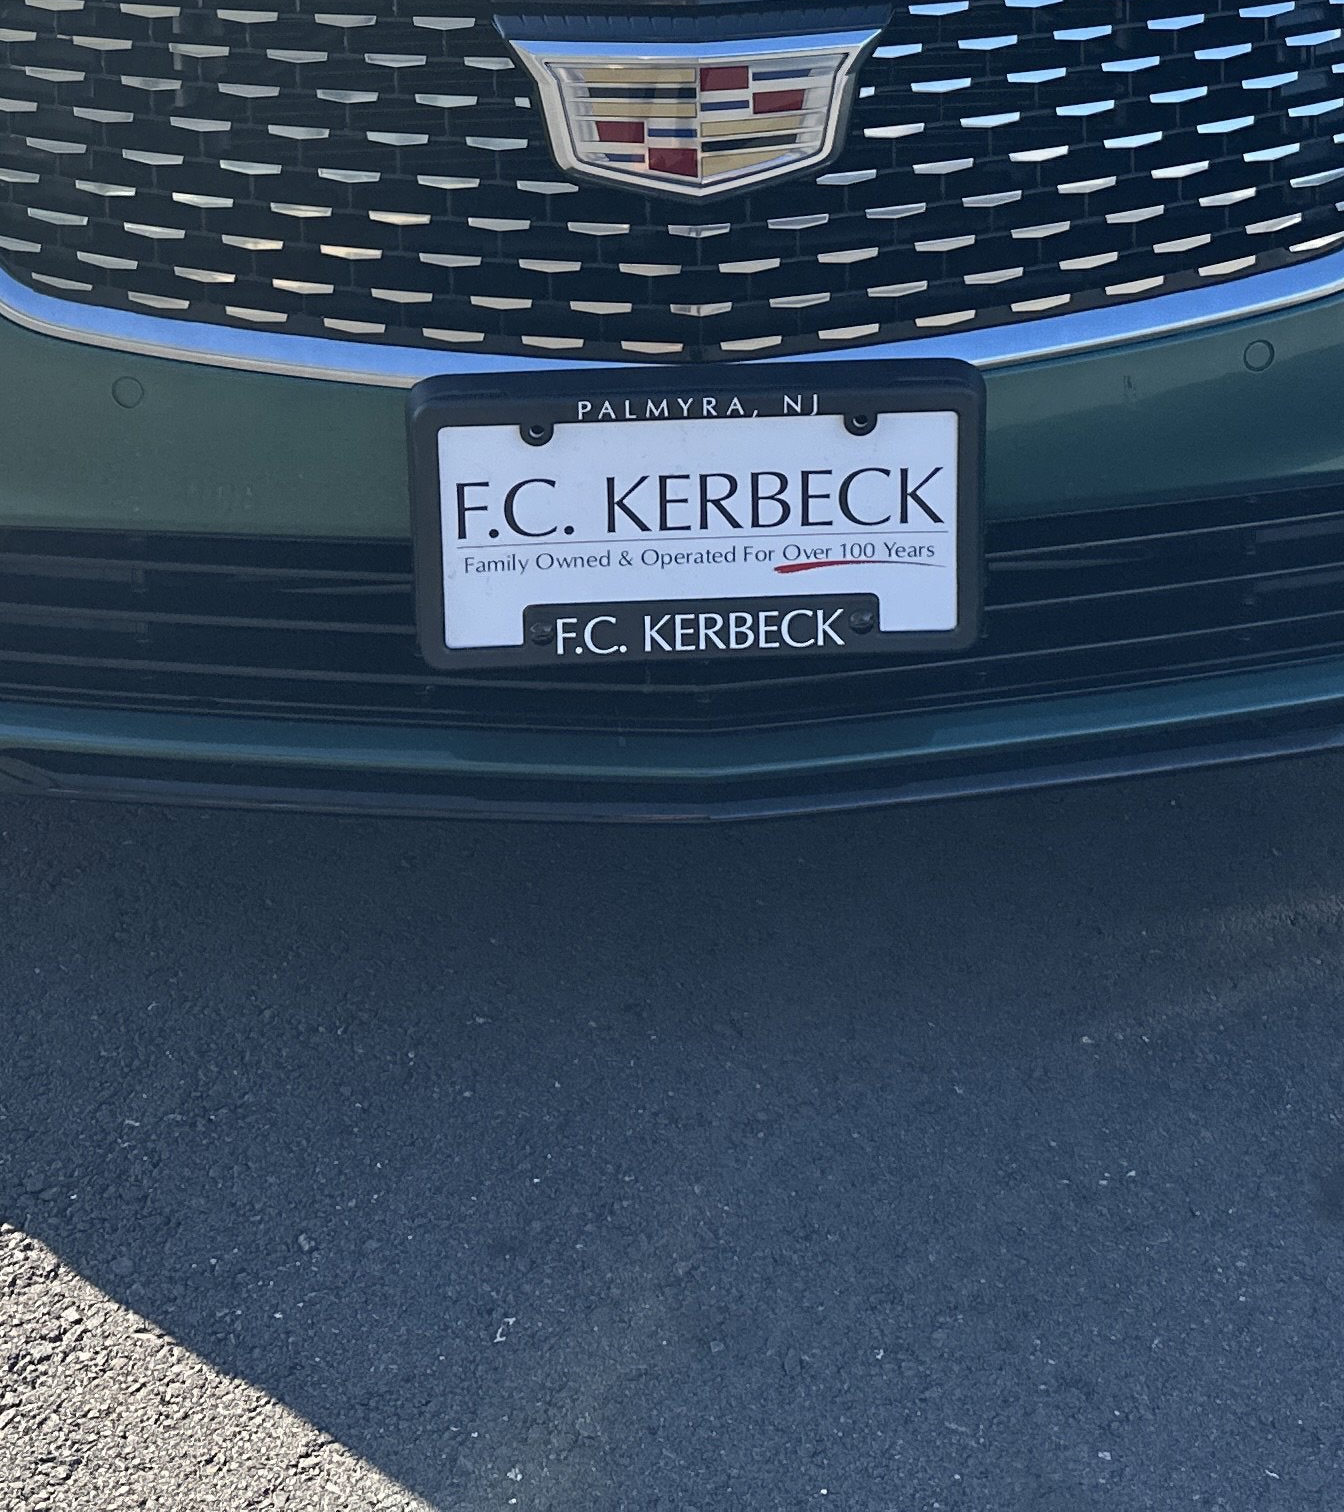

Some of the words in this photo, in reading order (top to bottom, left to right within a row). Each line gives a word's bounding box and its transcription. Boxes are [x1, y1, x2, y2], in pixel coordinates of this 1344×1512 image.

[578, 396, 758, 420] PALMYRA,
[783, 394, 818, 416] NJ
[456, 478, 575, 539] F.C.
[606, 467, 945, 533] KERBECK
[464, 553, 530, 575] Family
[535, 549, 611, 570] Owned
[618, 549, 633, 566] &
[641, 545, 736, 569] Operated
[743, 545, 775, 562] For
[782, 544, 833, 561] Over
[840, 542, 876, 559] 100
[883, 541, 935, 559] Years
[556, 616, 628, 655] F.C.
[643, 608, 846, 653] KERBECK
